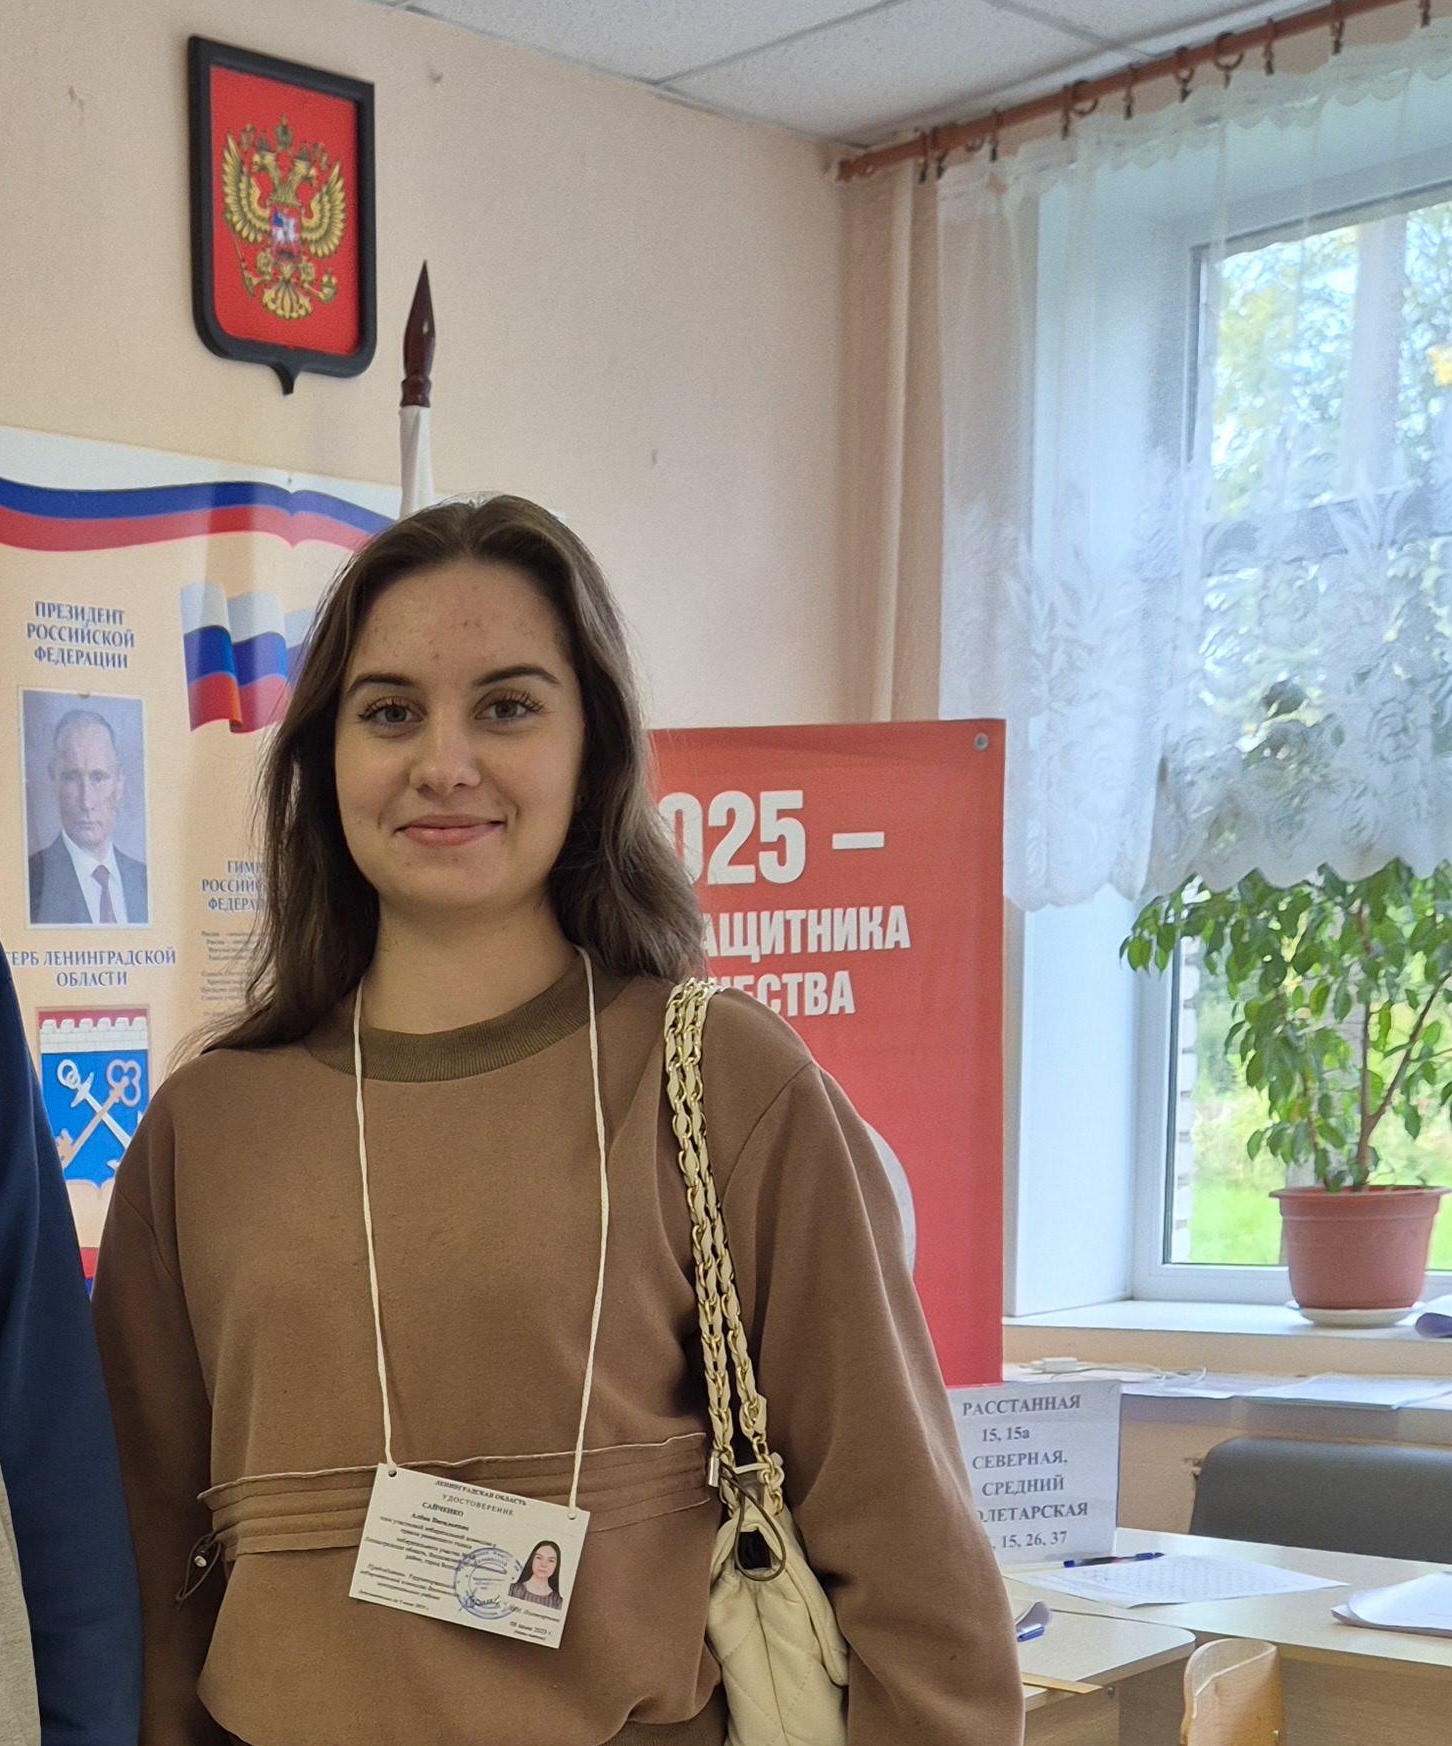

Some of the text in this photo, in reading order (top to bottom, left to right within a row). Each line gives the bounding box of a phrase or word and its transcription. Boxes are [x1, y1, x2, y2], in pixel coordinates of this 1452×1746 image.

[34, 600, 126, 626] ПРЕЗИДЕНТ
[26, 622, 135, 649] РОССИЙСКОЙ
[33, 645, 128, 670] ФЕДЕРАЦИИ
[208, 897, 261, 913] ФЕДЕРА
[42, 946, 176, 967] ЛЕНИНГРАДСКОЙ
[56, 970, 128, 987] ОБЛАСТИ
[962, 1394, 1081, 1416] РАССТАННАЯ
[981, 1426, 1030, 1443] 15, 15а
[971, 1449, 1068, 1470] СЕВЕРНАЯ,
[434, 1480, 527, 1506] ЛЕНИНГРАДСКАЯ ОБЛАСТЬ
[981, 1475, 1064, 1497] СРЕДНИЙ
[442, 1493, 514, 1516] УДОСТОВЕРЕНИЕ
[1001, 1535, 1021, 1549] 15,
[1025, 1532, 1047, 1547] 26,
[1050, 1530, 1067, 1545] 37
